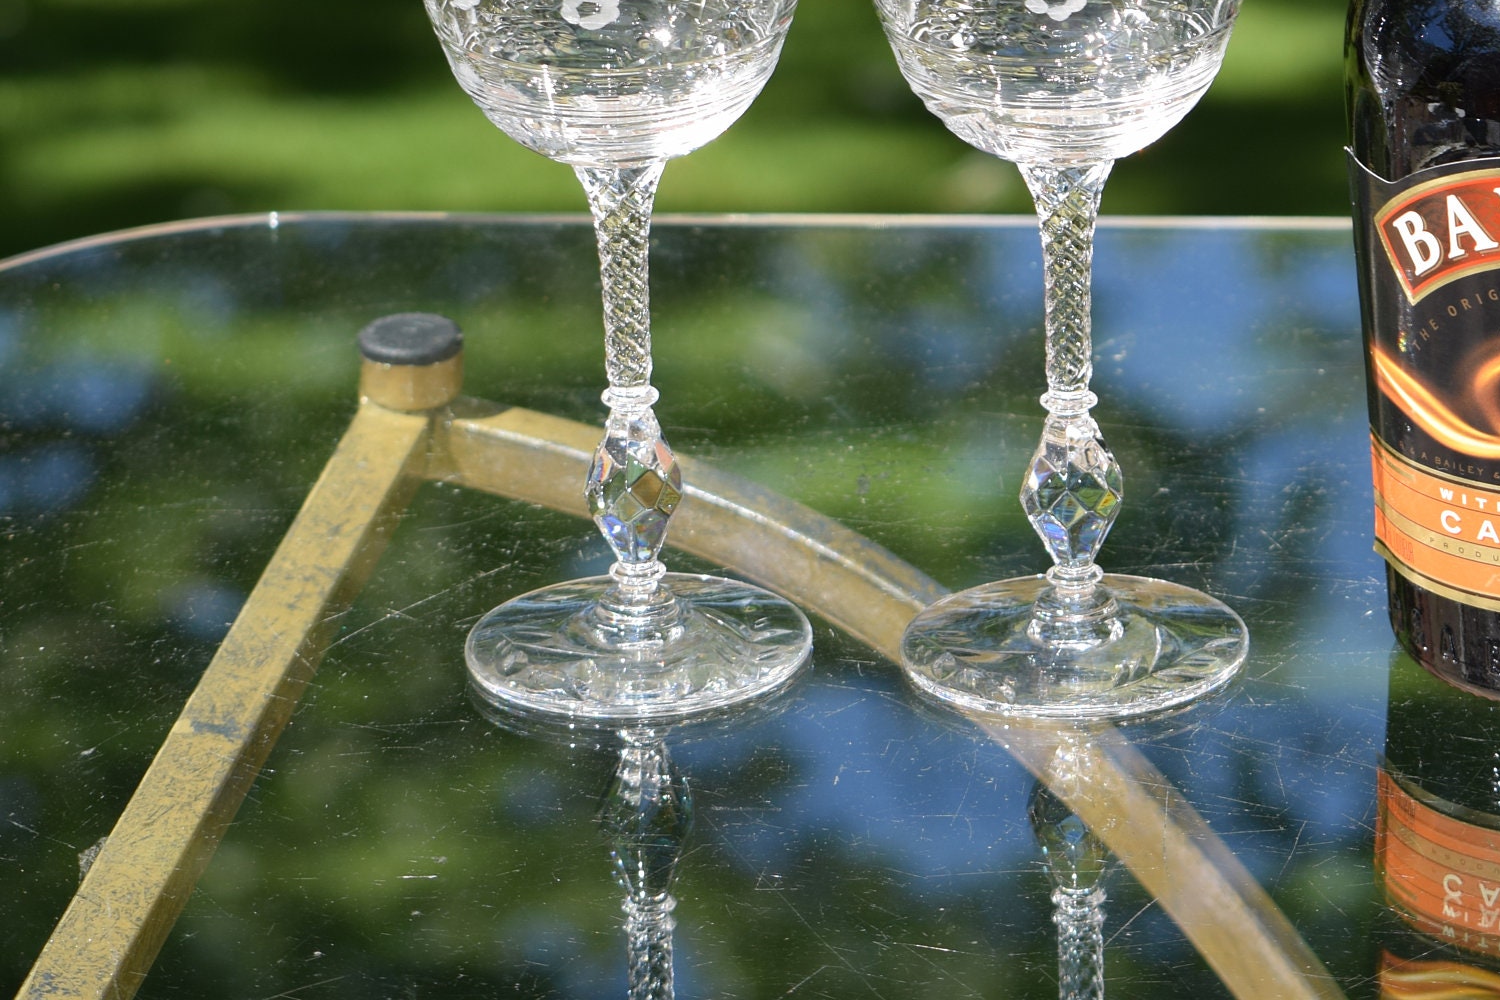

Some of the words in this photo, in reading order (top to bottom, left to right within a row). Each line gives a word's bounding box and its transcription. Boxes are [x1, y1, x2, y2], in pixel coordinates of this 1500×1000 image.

[1412, 318, 1440, 351] THE
[1434, 455, 1485, 478] BAILEY
[1493, 471, 1500, 479] &
